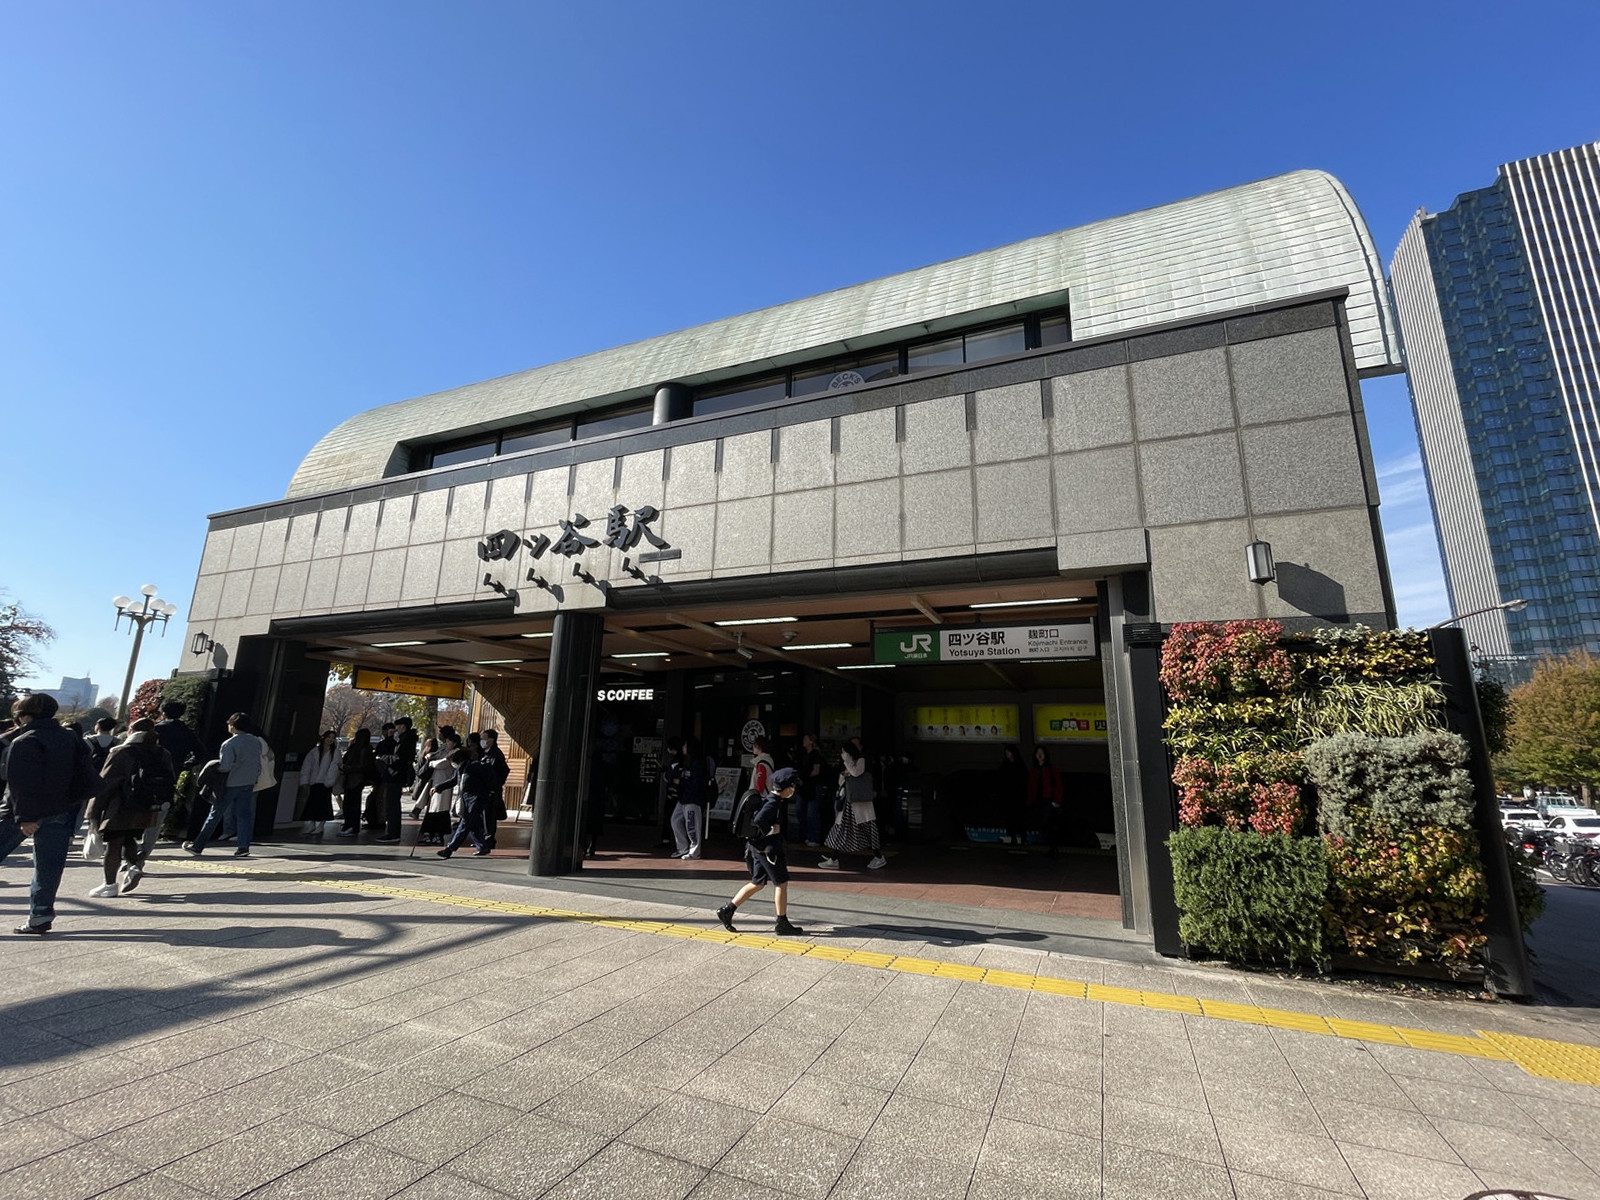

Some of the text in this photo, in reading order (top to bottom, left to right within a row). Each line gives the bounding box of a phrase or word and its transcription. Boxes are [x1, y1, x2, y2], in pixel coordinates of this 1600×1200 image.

[831, 372, 861, 388] BECK'S
[477, 504, 671, 562] 四ツ谷駅
[900, 634, 932, 653] JR
[948, 631, 1005, 646] 四ツ谷駅
[1059, 638, 1088, 646] Entrance
[949, 646, 1020, 658] Yotsuya Station
[606, 688, 654, 702] COFFEE
